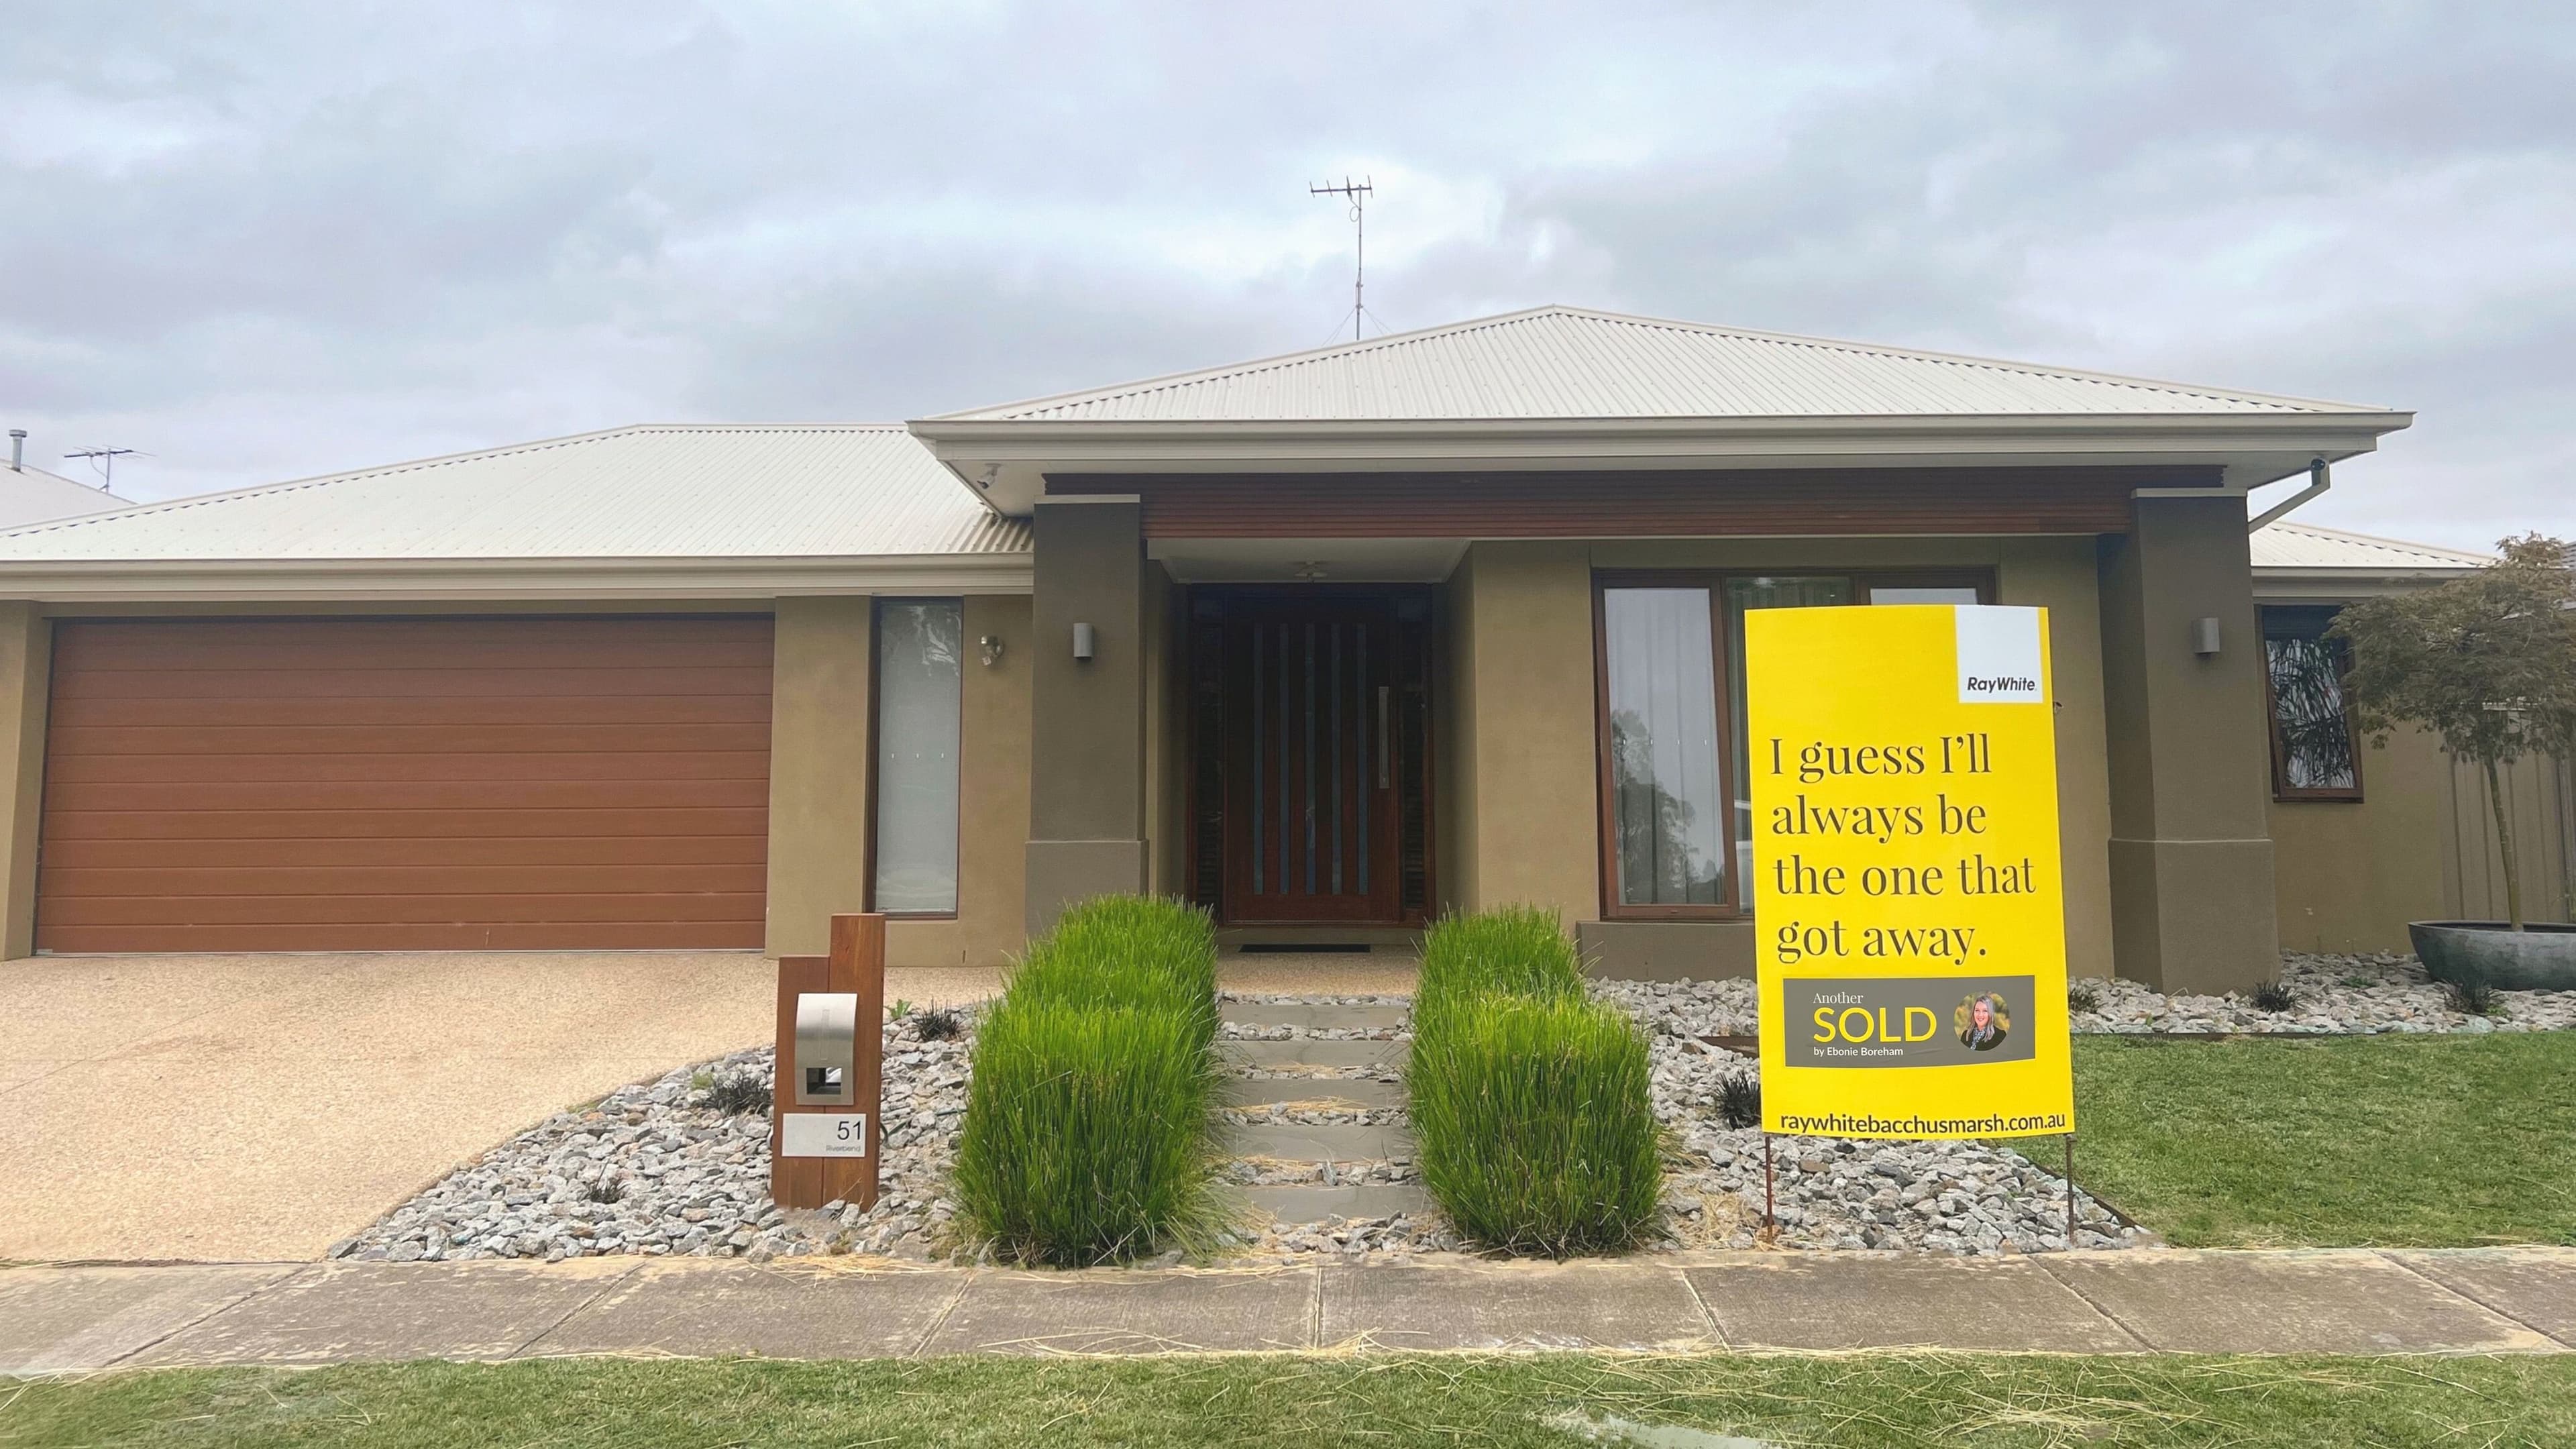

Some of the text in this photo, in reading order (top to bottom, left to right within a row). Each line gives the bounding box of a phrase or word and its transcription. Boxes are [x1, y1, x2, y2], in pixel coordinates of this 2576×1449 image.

[1770, 739, 1783, 775] I
[1799, 741, 1925, 784] guess
[1772, 794, 1986, 843] always be
[1773, 854, 2037, 896] the one that
[1777, 920, 1986, 965] got away.
[1813, 991, 1864, 1004] Another
[1813, 1007, 1937, 1042] SOLD
[1813, 1046, 1904, 1057] by Ebonie Boreham
[837, 1120, 861, 1140] 51
[1780, 1113, 2065, 1134] raywhitebacchusmarsh.com.au
